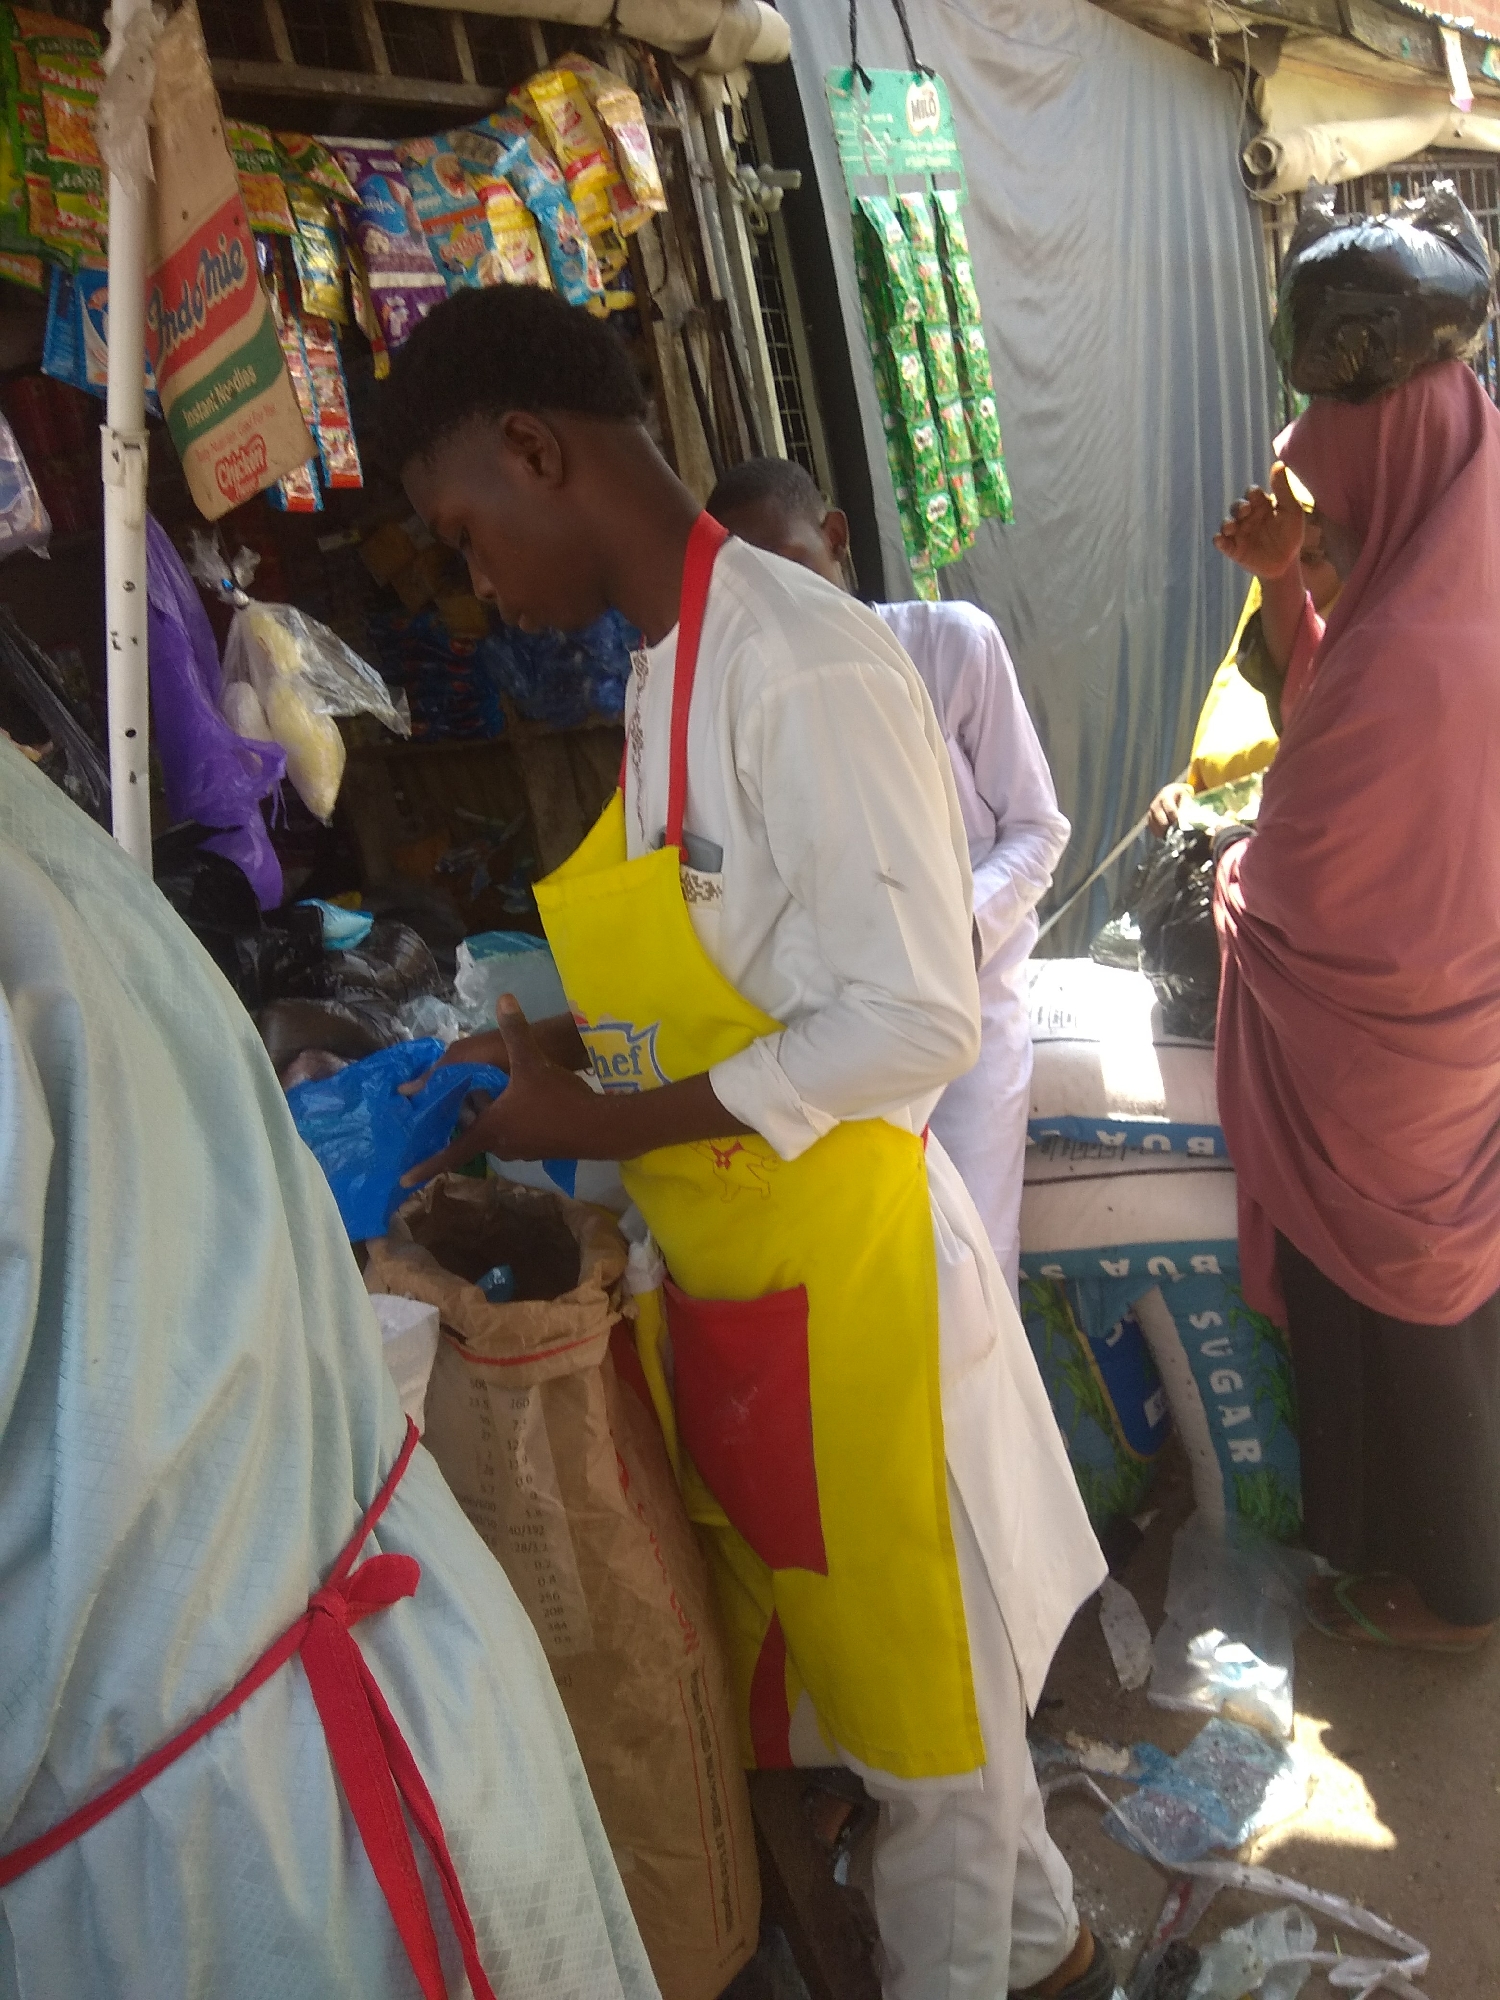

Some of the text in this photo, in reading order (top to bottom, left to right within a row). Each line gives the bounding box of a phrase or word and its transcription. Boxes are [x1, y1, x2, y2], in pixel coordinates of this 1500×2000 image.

[910, 97, 938, 122] MILO
[182, 363, 257, 431] Instant Noodles
[588, 1045, 642, 1080] hef
[1096, 1129, 1216, 1156] BUA
[1099, 1254, 1222, 1284] BUA
[1188, 1310, 1263, 1464] SUGAR
